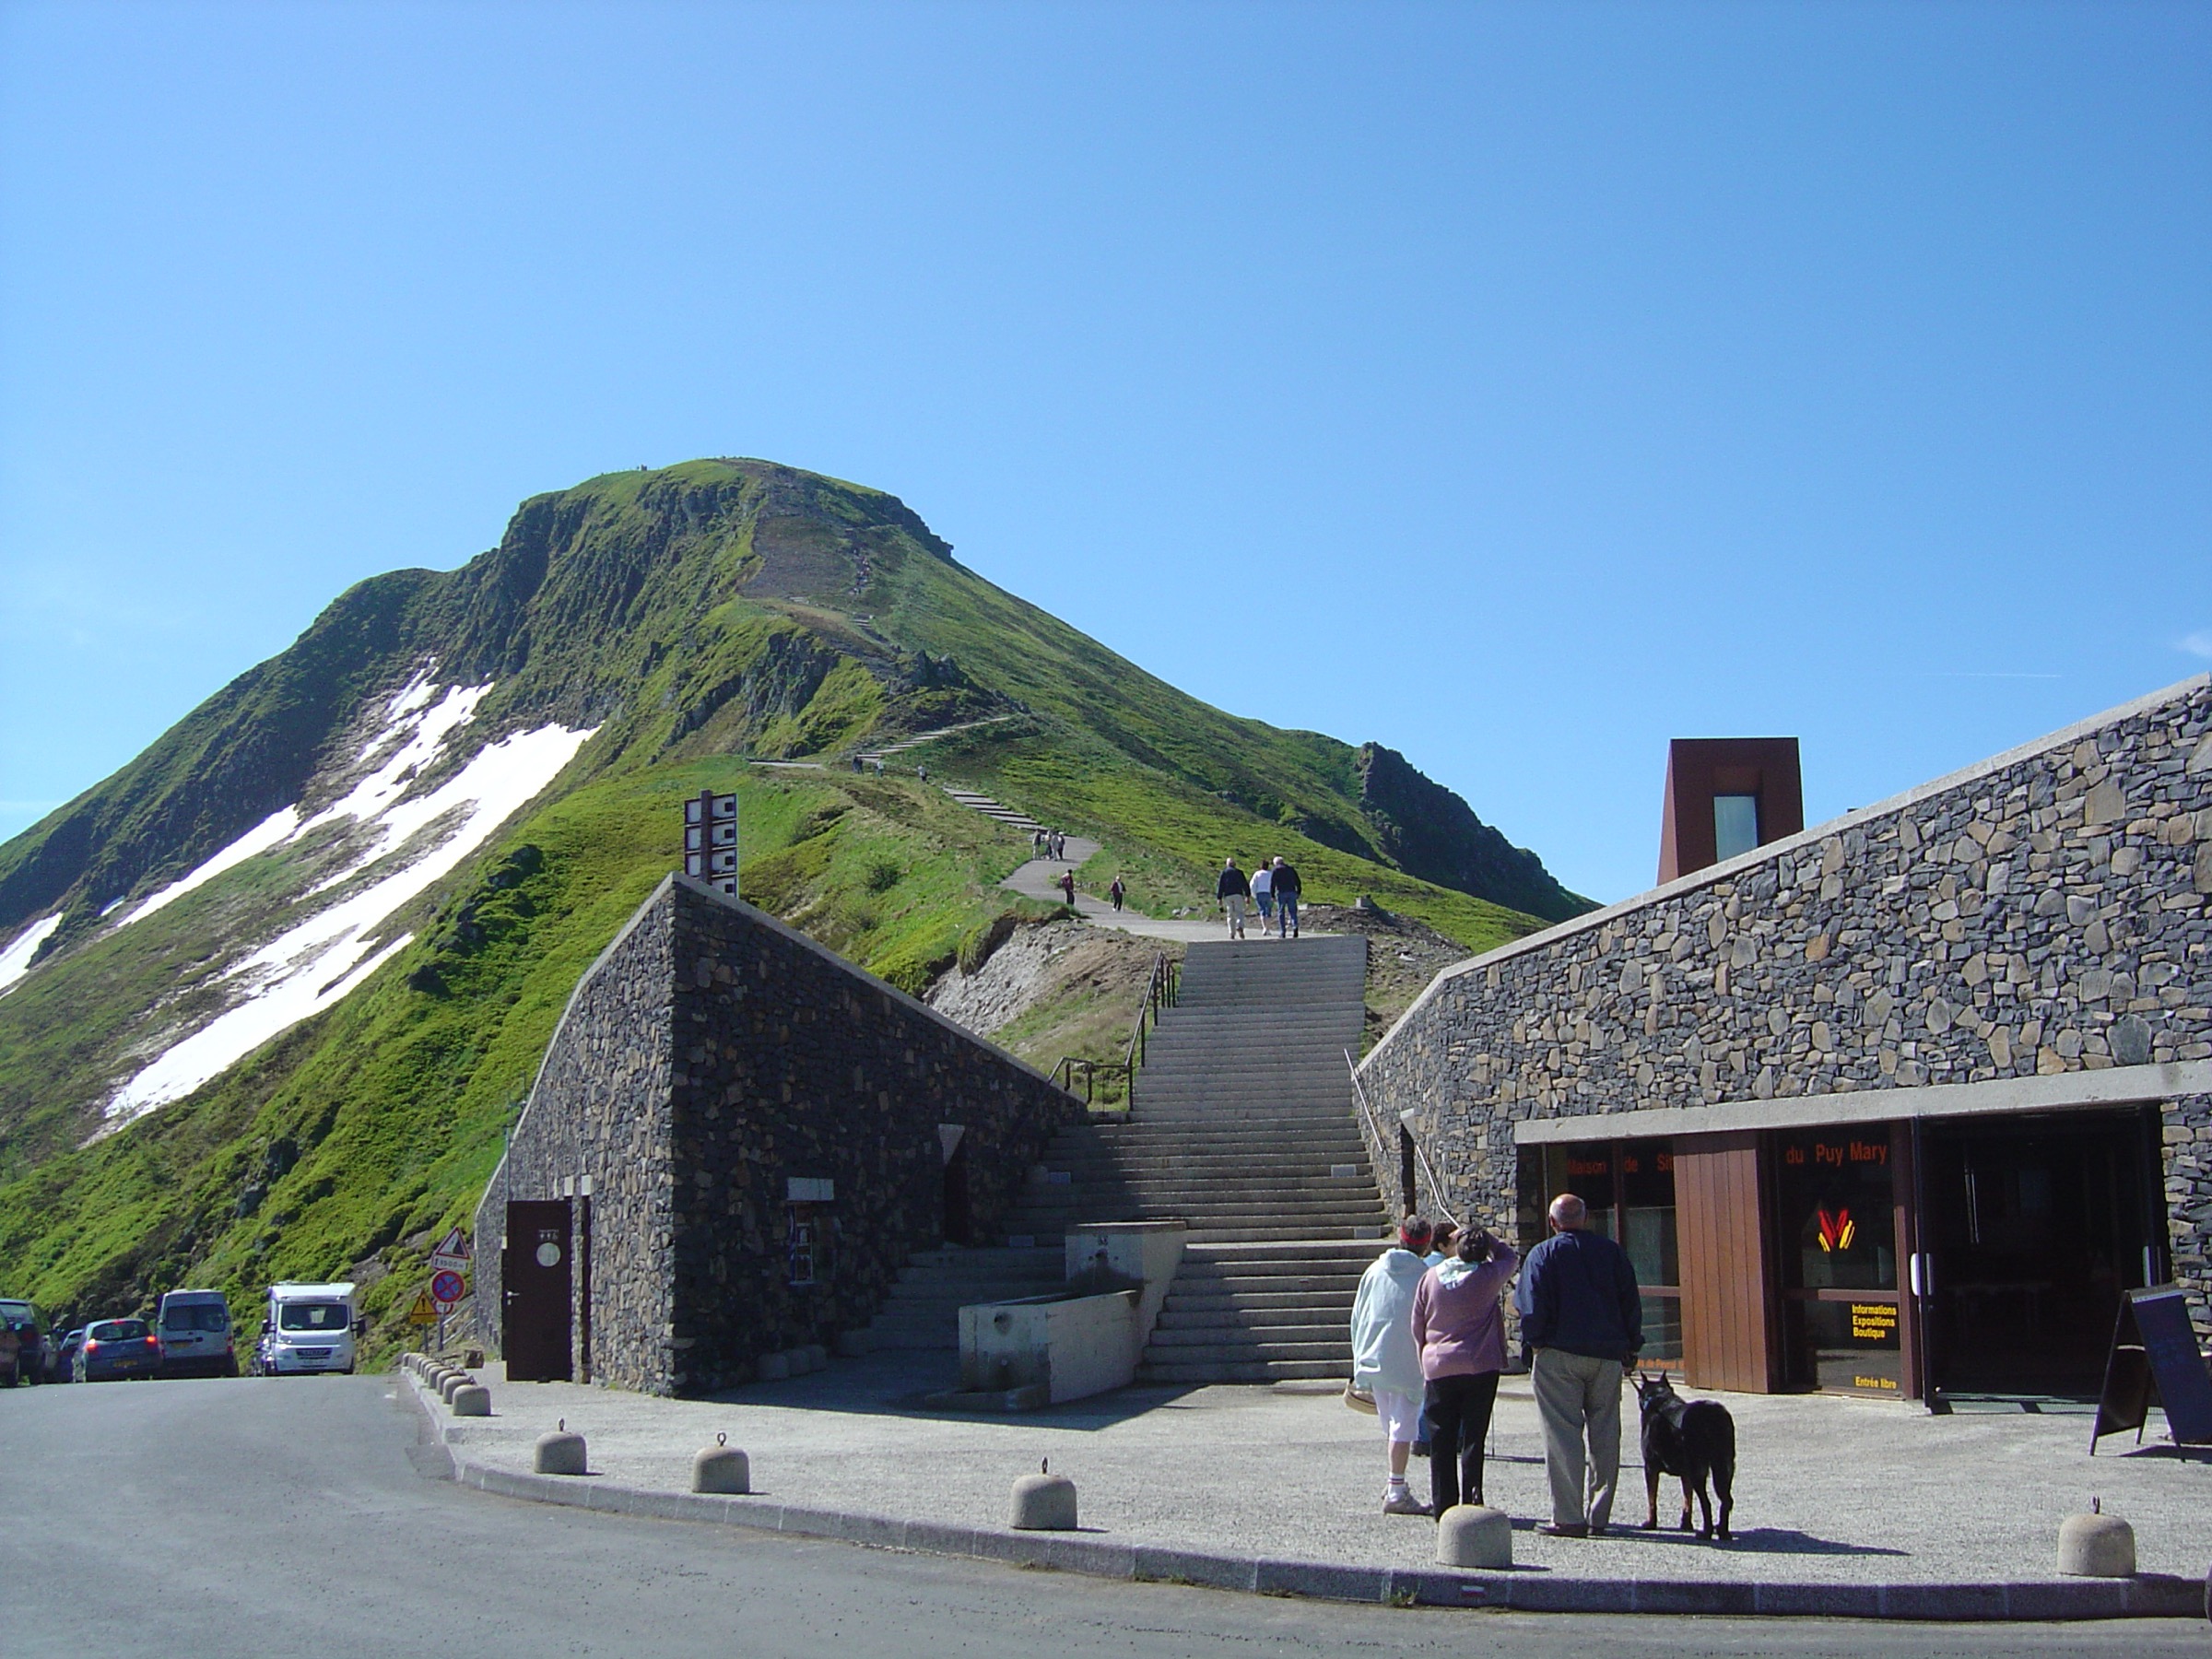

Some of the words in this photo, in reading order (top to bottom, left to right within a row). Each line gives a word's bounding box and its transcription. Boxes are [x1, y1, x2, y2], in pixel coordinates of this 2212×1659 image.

[1568, 1158, 1607, 1175] Maison
[1624, 1156, 1638, 1173] de
[1786, 1145, 1804, 1164] du
[1816, 1143, 1843, 1167] Puy
[1850, 1141, 1887, 1165] Mary
[1852, 1304, 1897, 1315] Informations
[1853, 1315, 1895, 1327] Expositions
[1853, 1326, 1886, 1340] Boutique
[1855, 1376, 1878, 1387] Entrée
[1880, 1378, 1897, 1389] libre
